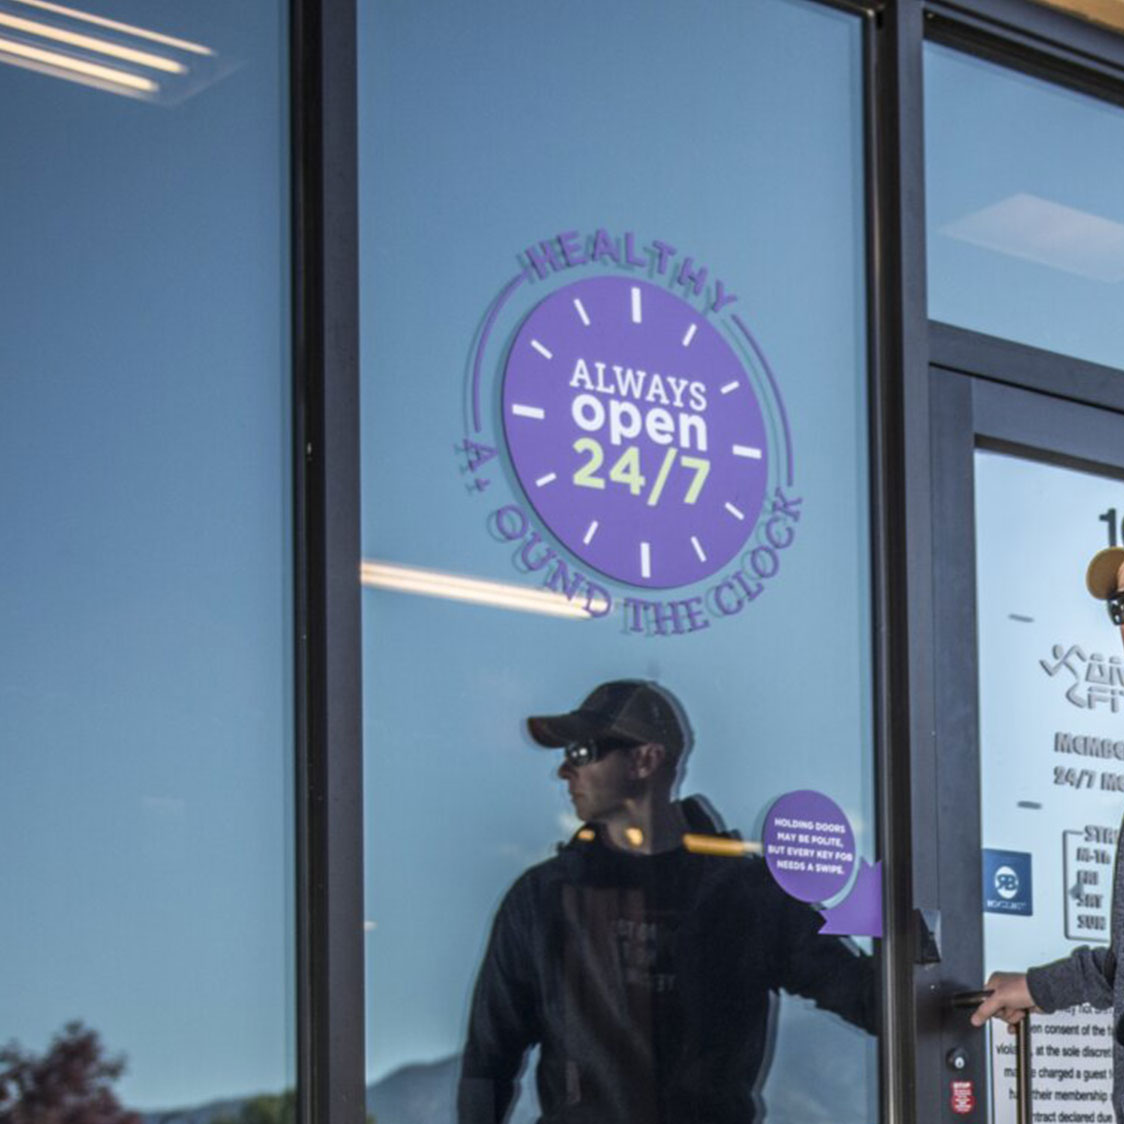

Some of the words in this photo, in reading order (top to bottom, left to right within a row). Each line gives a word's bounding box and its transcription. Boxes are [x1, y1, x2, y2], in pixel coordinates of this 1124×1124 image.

[520, 228, 738, 315] HEALTHY
[569, 358, 707, 412] ALWAYS
[571, 393, 708, 452] open
[572, 437, 711, 507] 24/7
[623, 597, 710, 636] THE
[712, 487, 803, 617] CLOCK
[1053, 765, 1096, 790] 24/7
[774, 818, 814, 831] HOLDING
[815, 822, 846, 834] DOORS
[777, 832, 797, 842] MAY
[798, 834, 810, 844] BE
[811, 835, 844, 849] POLITE,
[767, 844, 786, 854] BUT
[787, 846, 815, 857] EVERY
[816, 850, 834, 860] KEY
[776, 860, 806, 871] NEEDS
[807, 863, 814, 872] A
[815, 863, 845, 875] SWIPE.
[1044, 1024, 1080, 1036] consent
[1081, 1024, 1091, 1036] of
[1092, 1024, 1106, 1037] the
[1036, 1046, 1045, 1057] at
[1046, 1045, 1060, 1057] the
[1062, 1046, 1081, 1057] sole
[1038, 1067, 1074, 1082] charged
[1076, 1069, 1081, 1079] a
[1083, 1069, 1107, 1082] guest
[1054, 1089, 1108, 1104] membership
[1058, 1111, 1095, 1123] declared
[1097, 1111, 1113, 1123] due
